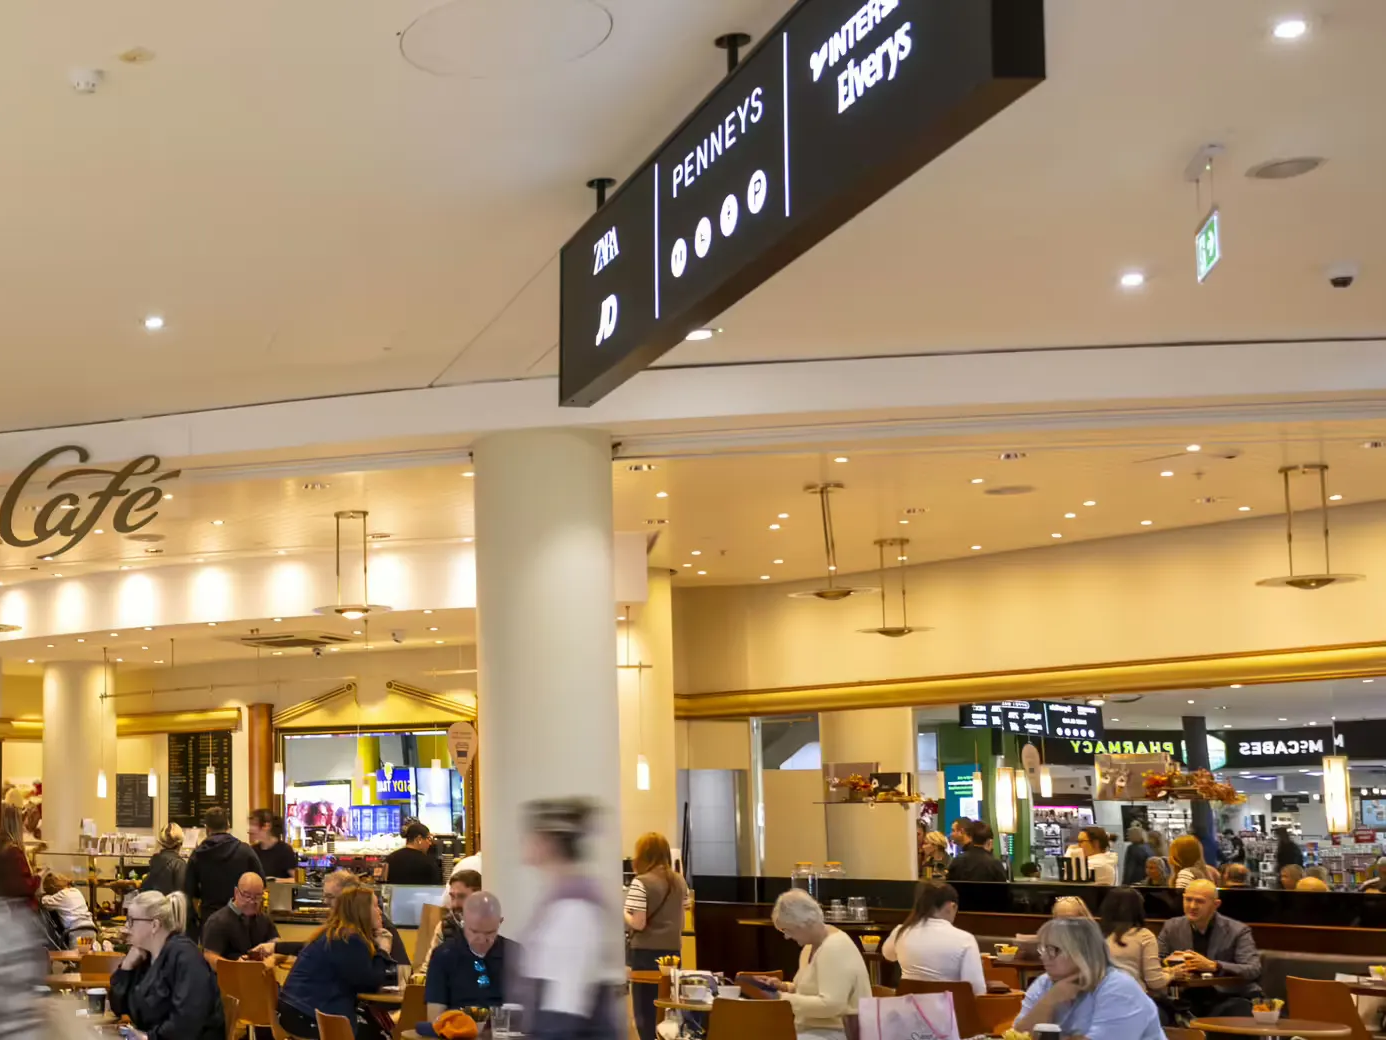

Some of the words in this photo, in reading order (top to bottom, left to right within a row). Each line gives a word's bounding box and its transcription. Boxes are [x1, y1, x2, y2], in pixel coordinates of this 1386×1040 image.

[837, 21, 912, 114] Elverys
[673, 87, 763, 198] PENNEYS
[593, 226, 620, 276] ZARA
[595, 294, 618, 347] JD
